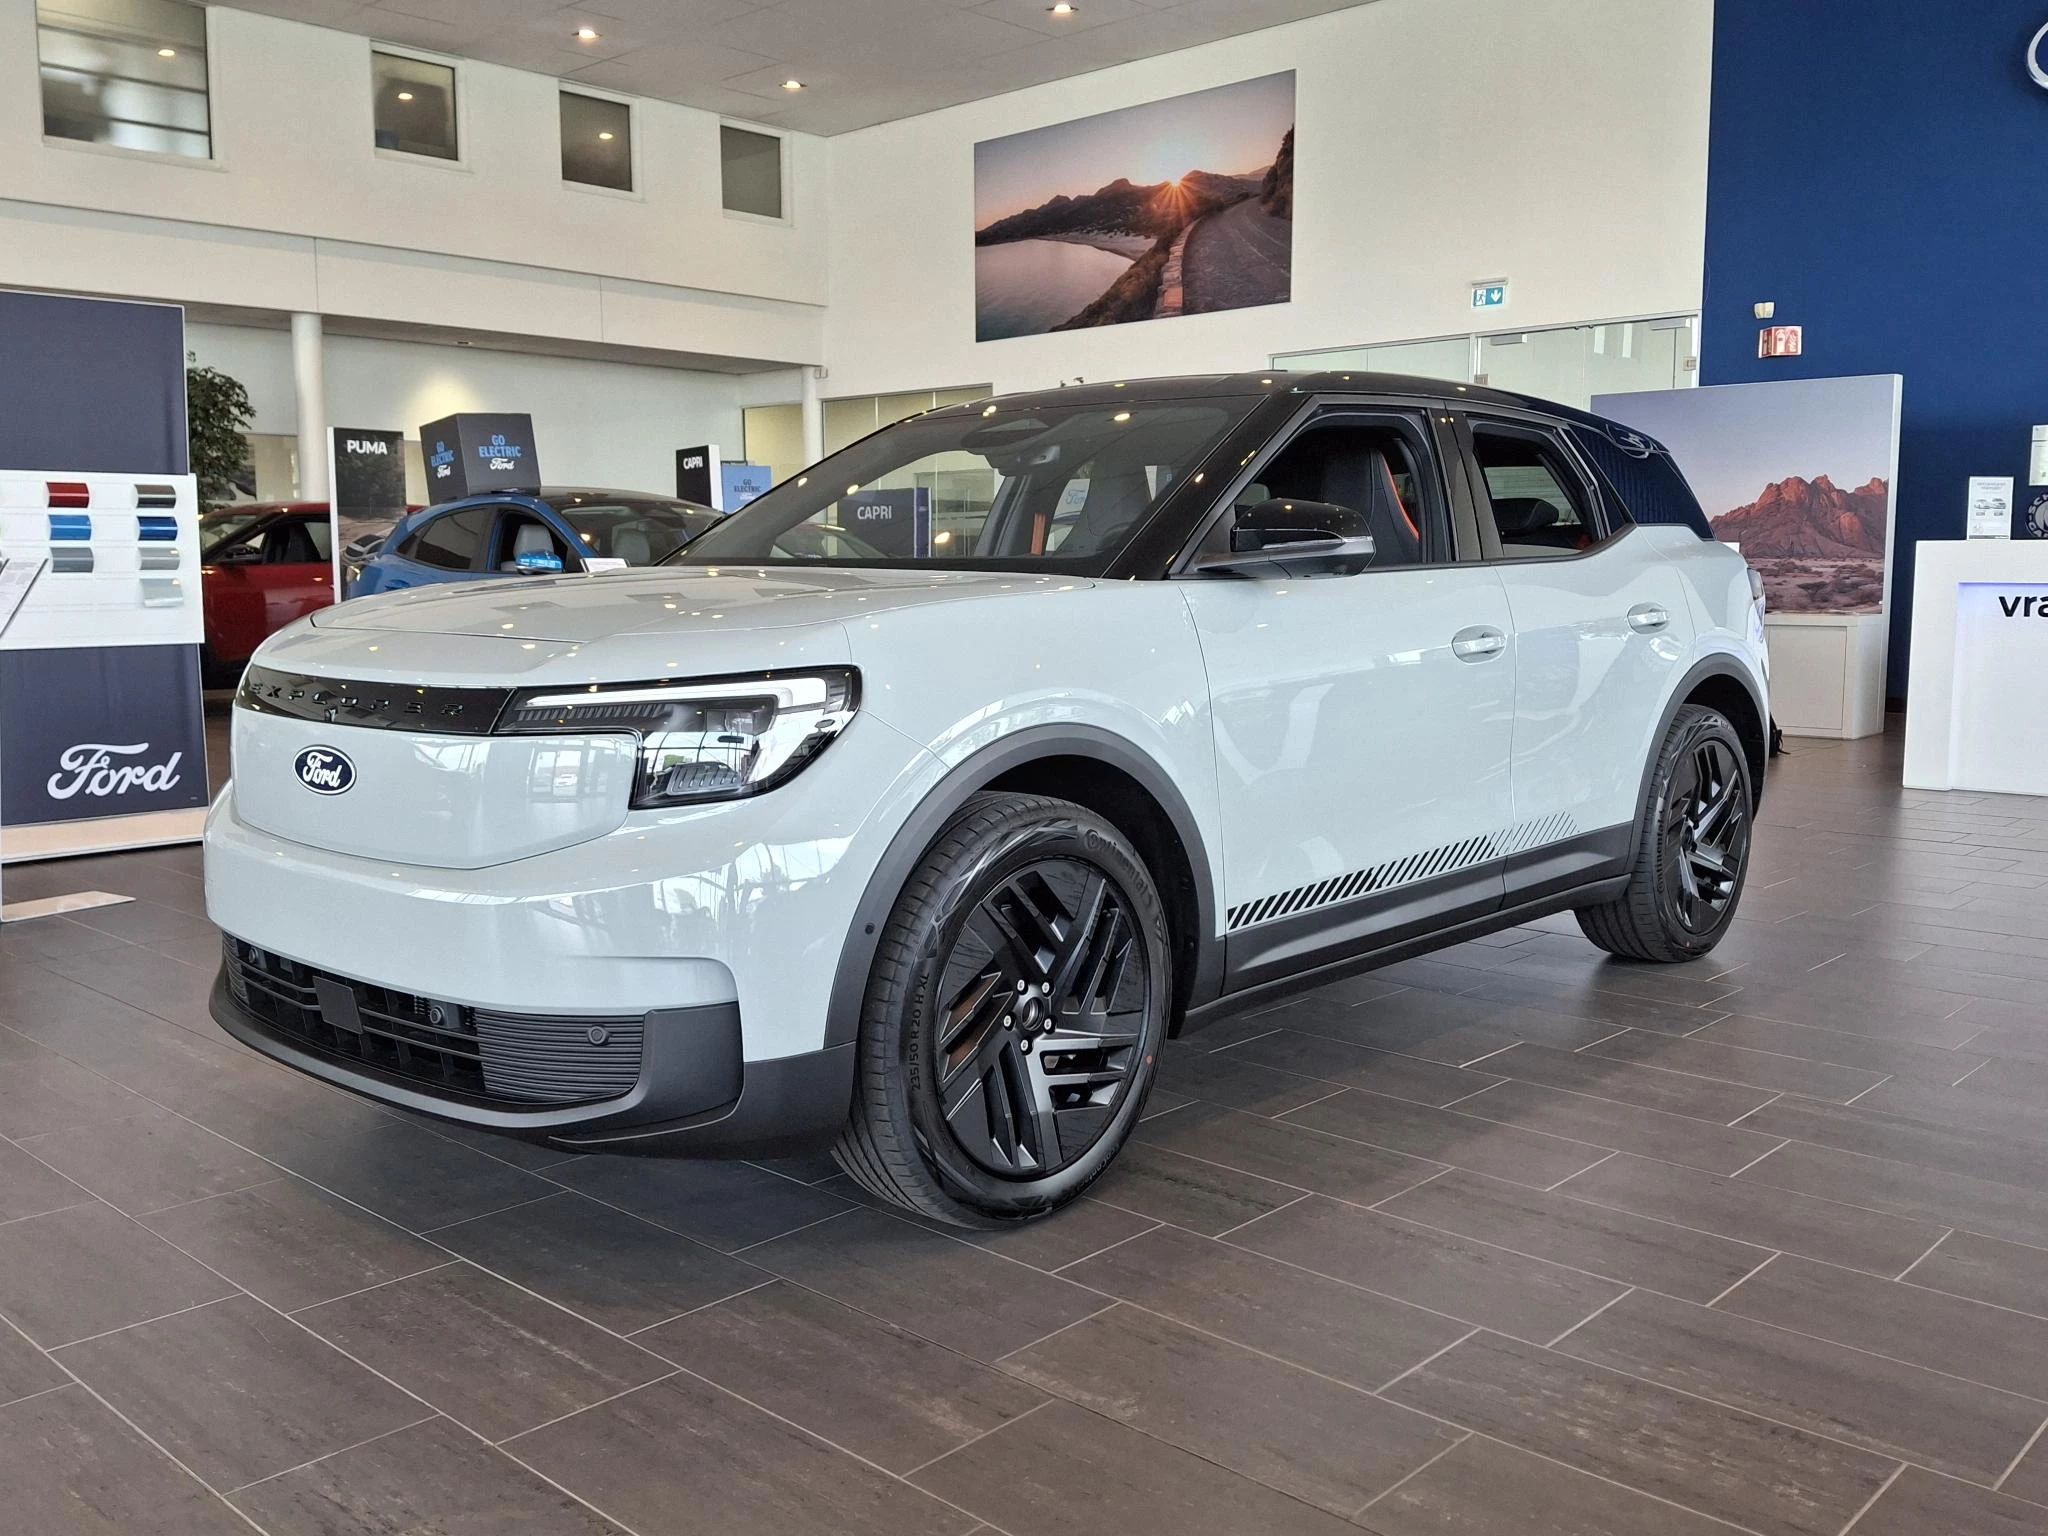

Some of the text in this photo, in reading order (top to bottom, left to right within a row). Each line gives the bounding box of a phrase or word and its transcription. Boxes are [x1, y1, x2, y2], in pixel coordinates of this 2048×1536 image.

[346, 439, 388, 455] PUMA
[491, 435, 506, 446] GO
[478, 446, 522, 458] ELECTRIC
[489, 457, 515, 471] Ford
[683, 456, 703, 470] CAPRI
[856, 504, 892, 520] CAPRI
[1998, 596, 2048, 618] vra
[47, 742, 183, 800] Ford
[302, 751, 343, 788] Ford
[909, 972, 929, 1091] 235/50 R 20 H XL
